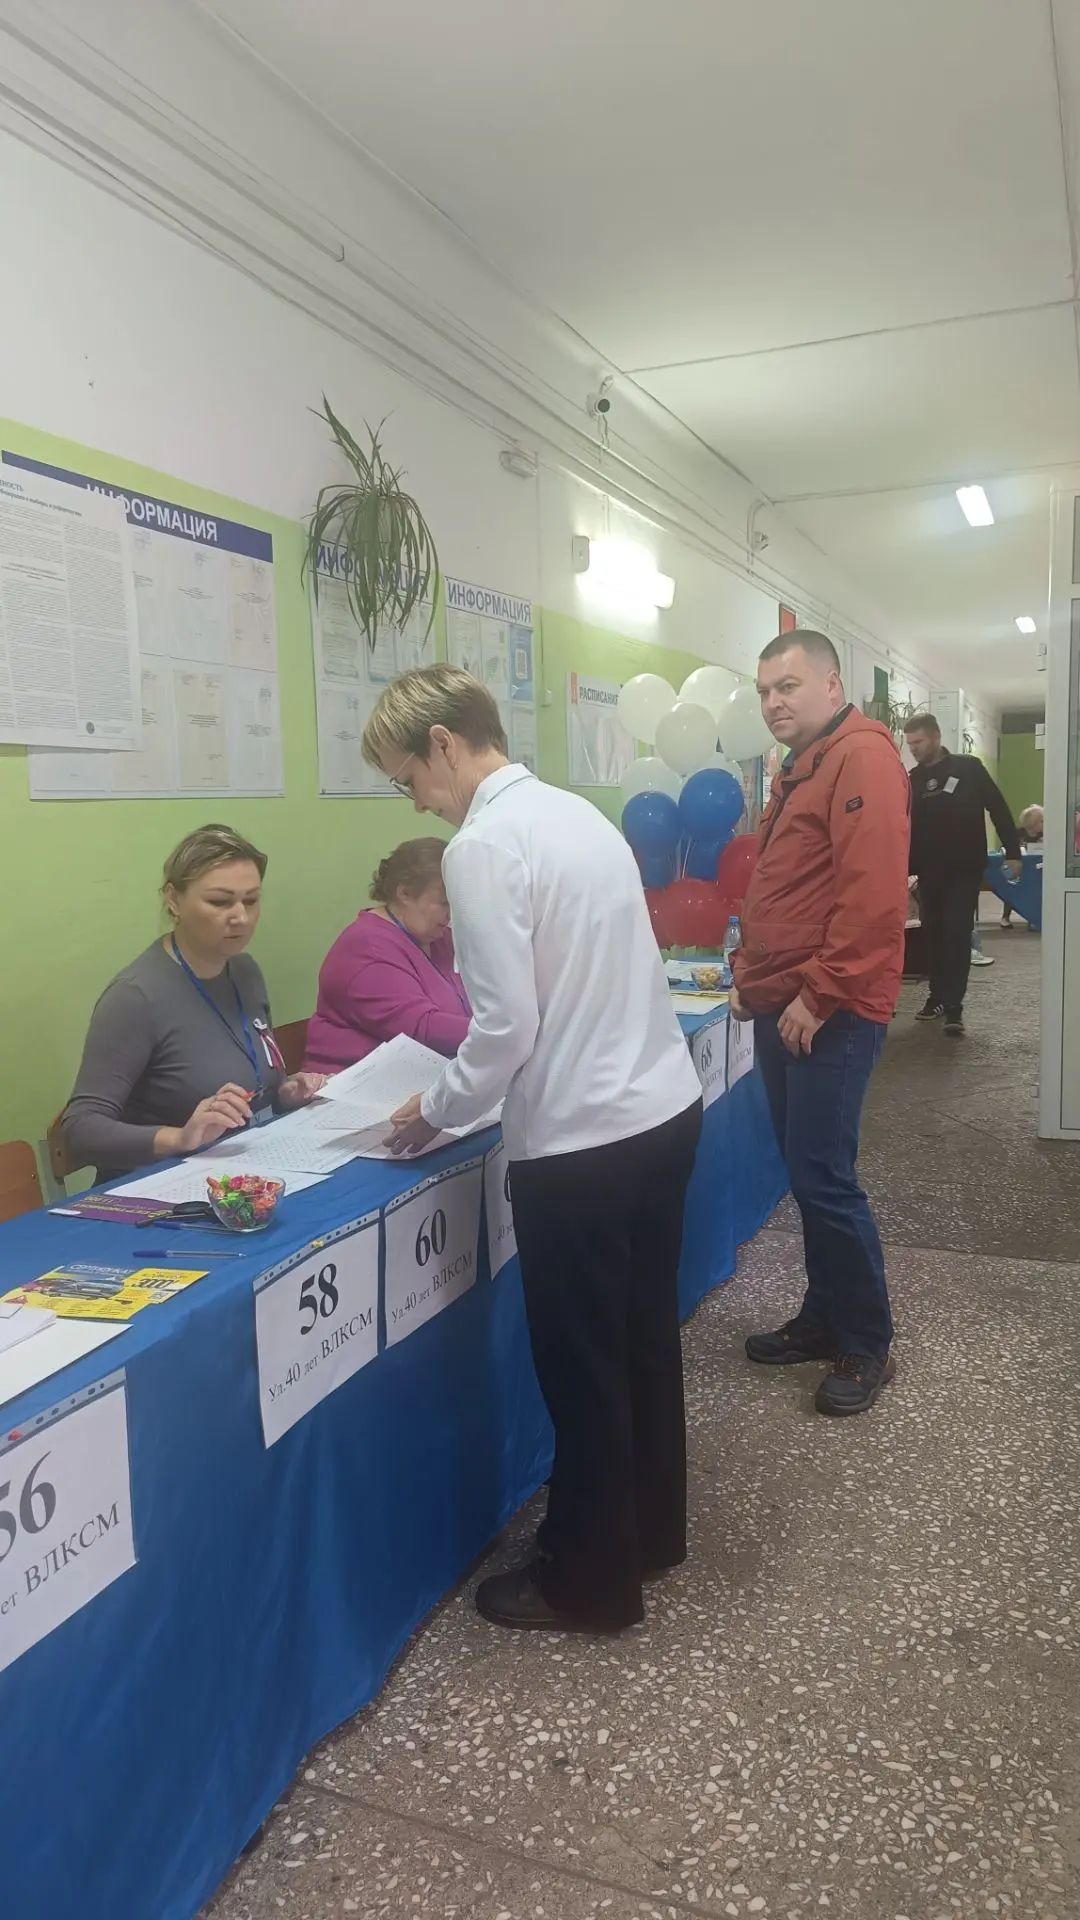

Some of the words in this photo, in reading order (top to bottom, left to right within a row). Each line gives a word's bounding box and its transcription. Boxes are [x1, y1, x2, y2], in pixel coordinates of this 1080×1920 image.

[447, 582, 532, 624] ИНФОРМАЦИЯ
[701, 1039, 712, 1073] 68
[414, 1208, 447, 1267] 60
[298, 1262, 339, 1336] 58
[431, 1249, 473, 1293] ВЛКСМ
[303, 1354, 319, 1376] лет
[321, 1307, 374, 1359] ВЛКСМ
[24, 1500, 121, 1597] ВЛКСМ
